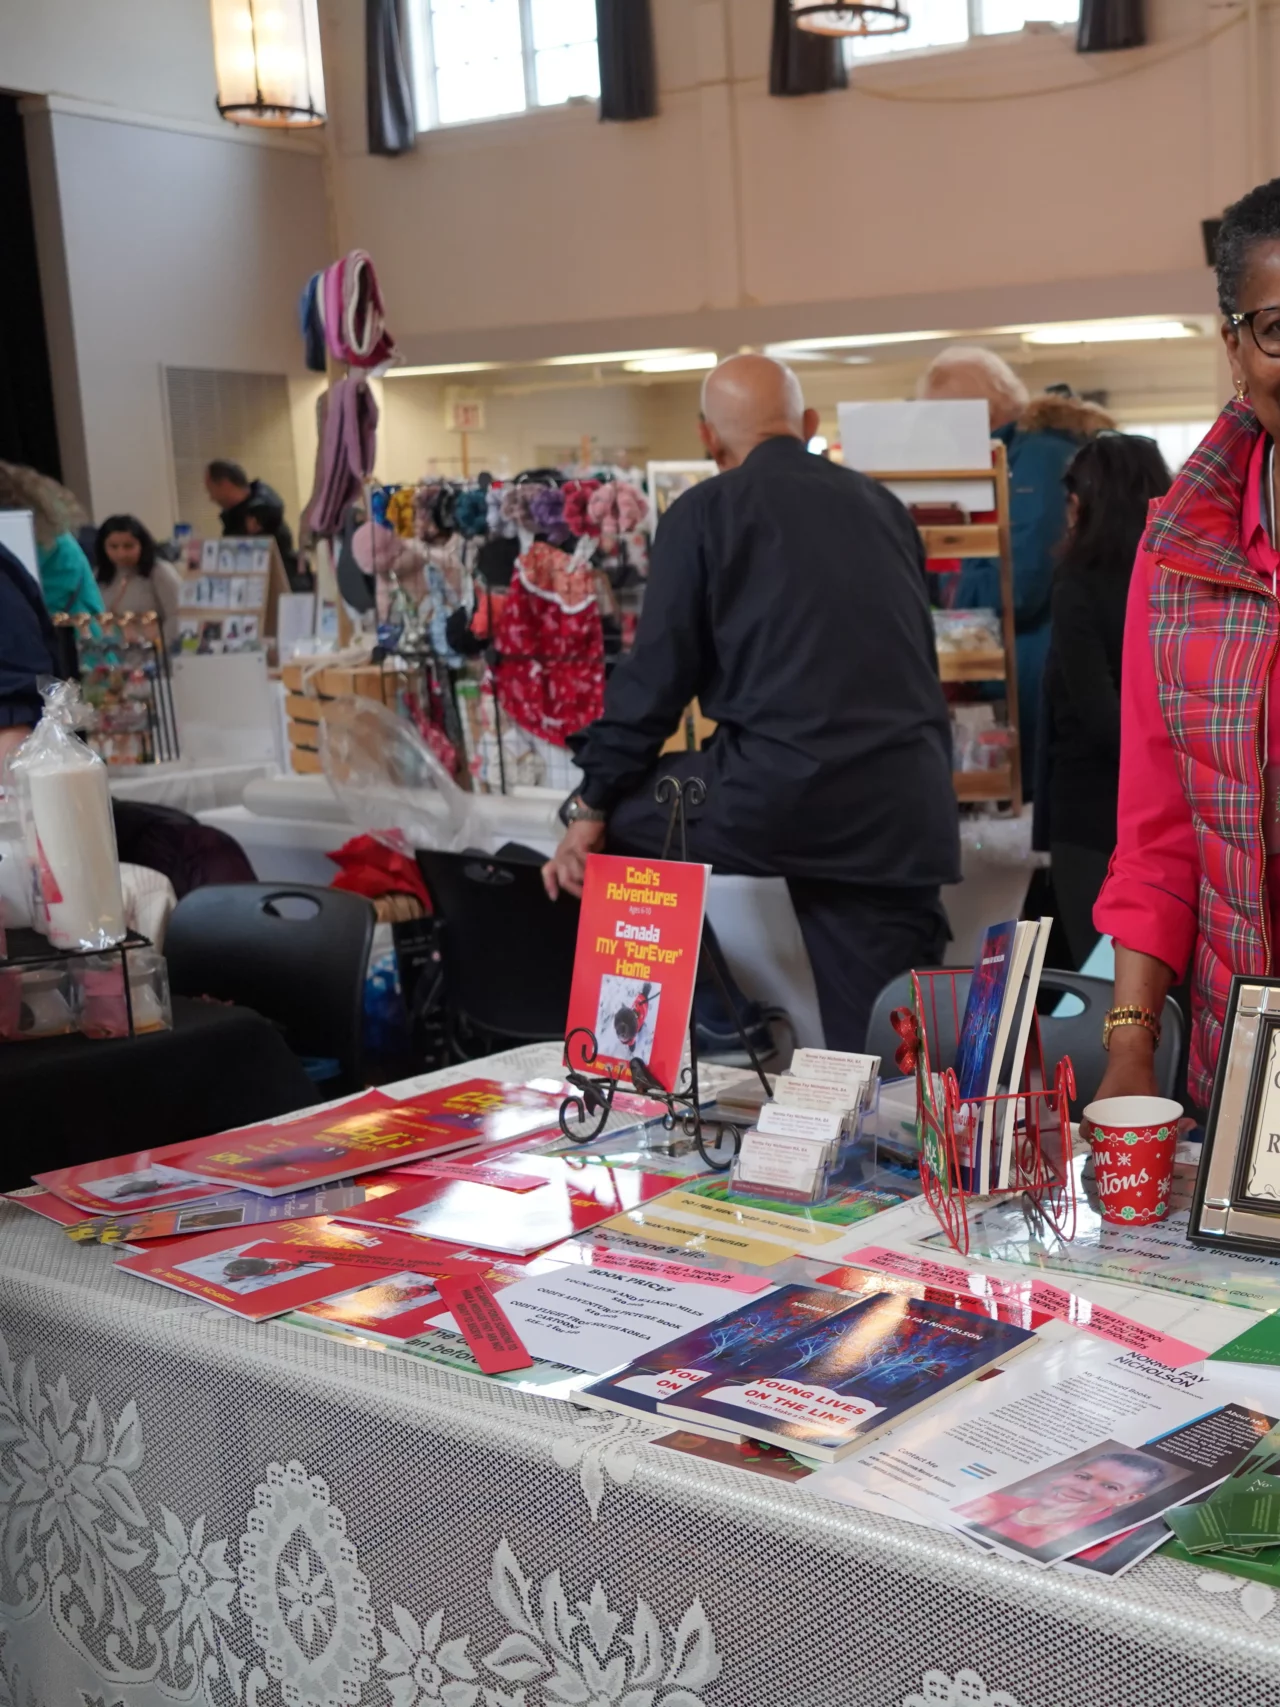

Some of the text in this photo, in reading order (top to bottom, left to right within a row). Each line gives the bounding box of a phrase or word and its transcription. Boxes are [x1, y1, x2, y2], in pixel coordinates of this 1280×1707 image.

[626, 866, 660, 886] Codi's
[606, 882, 678, 907] Adventures
[615, 920, 660, 943] Canada
[594, 1232, 706, 1260] someone's life
[1117, 1246, 1170, 1262] of hope
[1142, 1236, 1206, 1253] channels
[1210, 1248, 1265, 1265] through
[588, 1268, 628, 1282] BOOK
[627, 1264, 660, 1272] BEFORE
[1043, 1288, 1061, 1298] YOU
[1152, 1272, 1228, 1293] Youth Violence
[537, 1287, 564, 1300] CODI'S
[621, 1308, 655, 1322] PICTURE
[656, 1318, 684, 1330] BOOK
[564, 1278, 594, 1290] YOUNG
[595, 1286, 617, 1296] LIVES
[618, 1291, 637, 1302] AND
[677, 1306, 704, 1317] MILES
[510, 1300, 652, 1341] CODI'S FLIGHT SOUTH KOREA
[912, 1317, 984, 1342] FAY NICHOLSON
[1094, 1308, 1166, 1343] ALWAYS CONTROL
[1094, 1317, 1150, 1342] BUT YOU CAN
[1104, 1328, 1150, 1350] THOUGHTS
[1114, 1356, 1195, 1388] NICHOLSON
[1126, 1351, 1177, 1373] NORMA
[1178, 1370, 1210, 1384] FAY
[656, 1379, 682, 1391] ON
[756, 1377, 867, 1416] YOUNG LIVES
[1083, 1370, 1152, 1400] My Authored Books
[744, 1388, 853, 1427] ON THE LINE
[776, 1406, 793, 1416] Make
[1225, 1410, 1250, 1422] About
[898, 1447, 938, 1469] Contact Me
